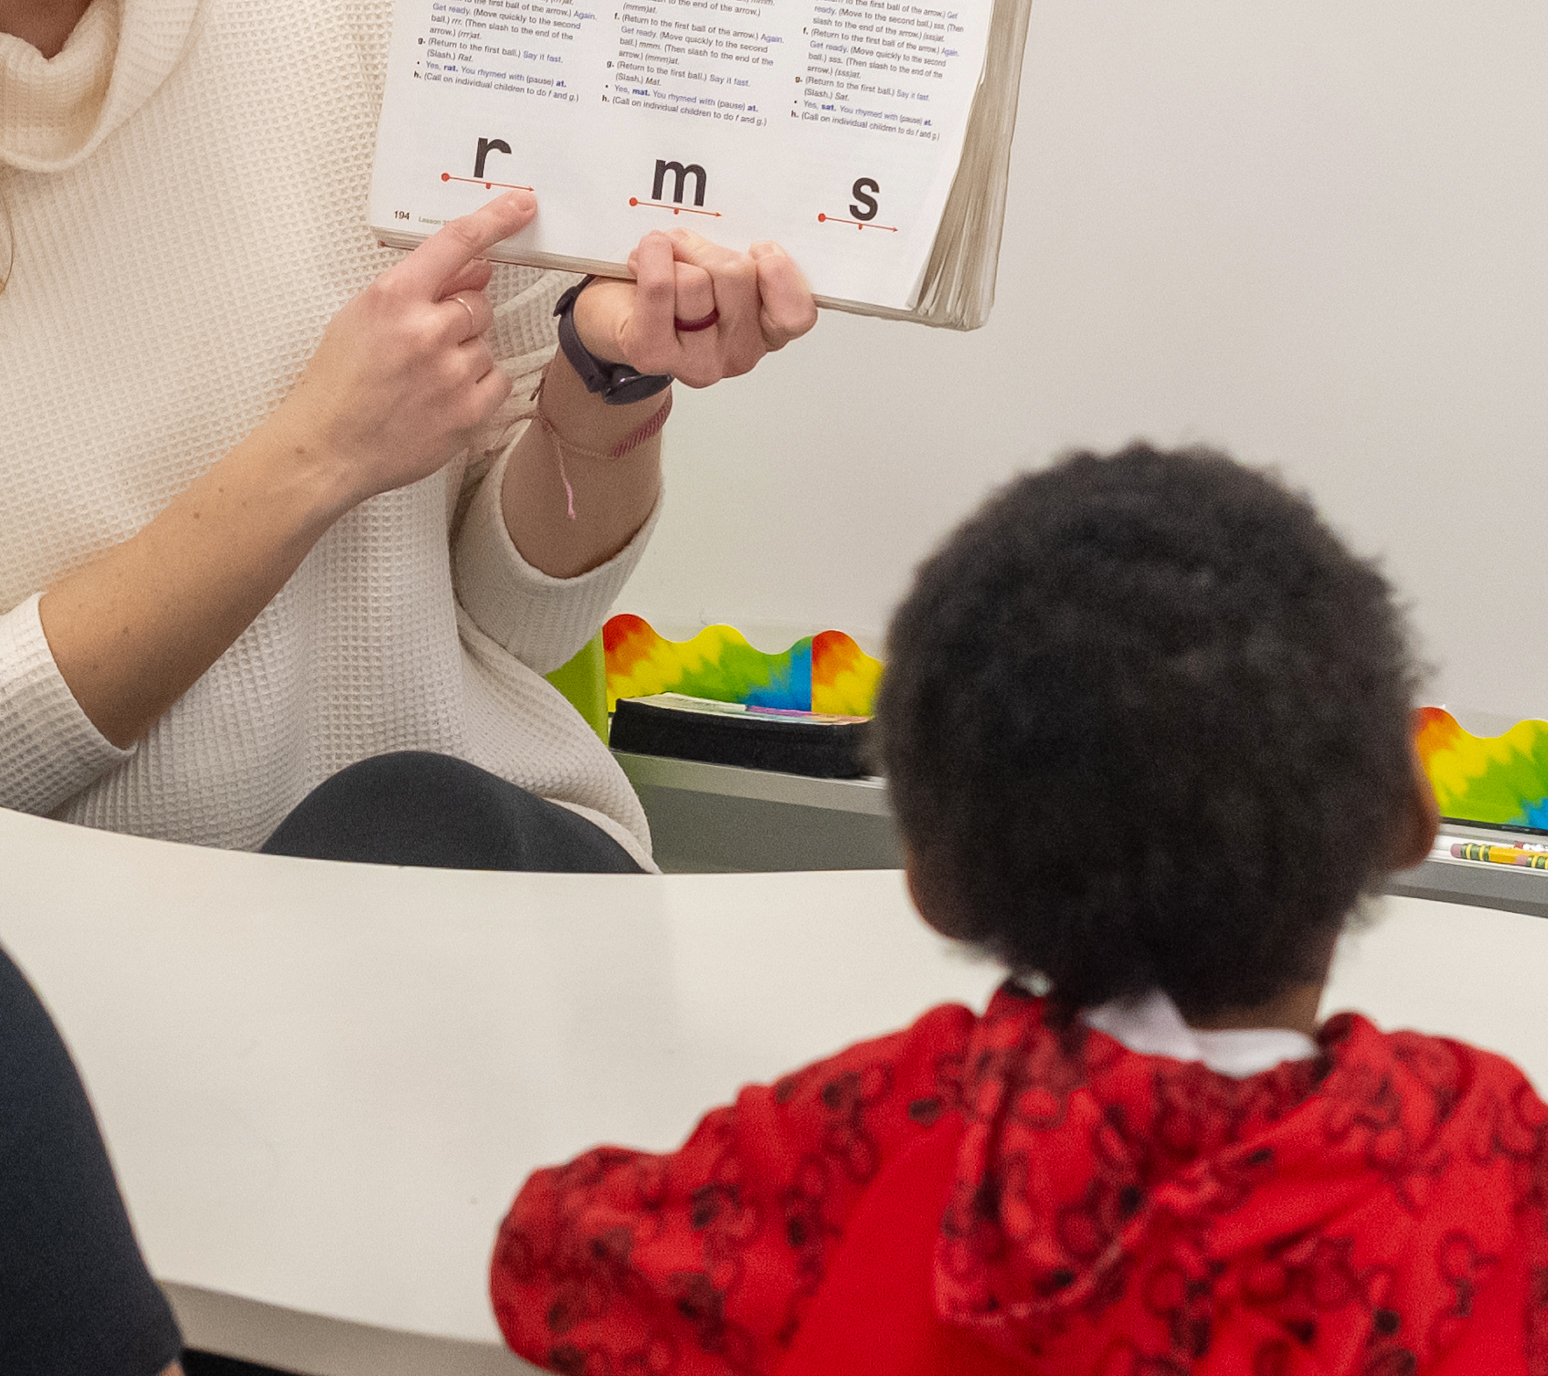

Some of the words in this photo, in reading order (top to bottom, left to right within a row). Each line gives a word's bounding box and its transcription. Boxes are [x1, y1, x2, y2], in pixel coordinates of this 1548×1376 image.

[473, 137, 512, 178] r
[651, 159, 707, 208] m
[849, 177, 880, 221] s
[393, 210, 410, 221] 194
